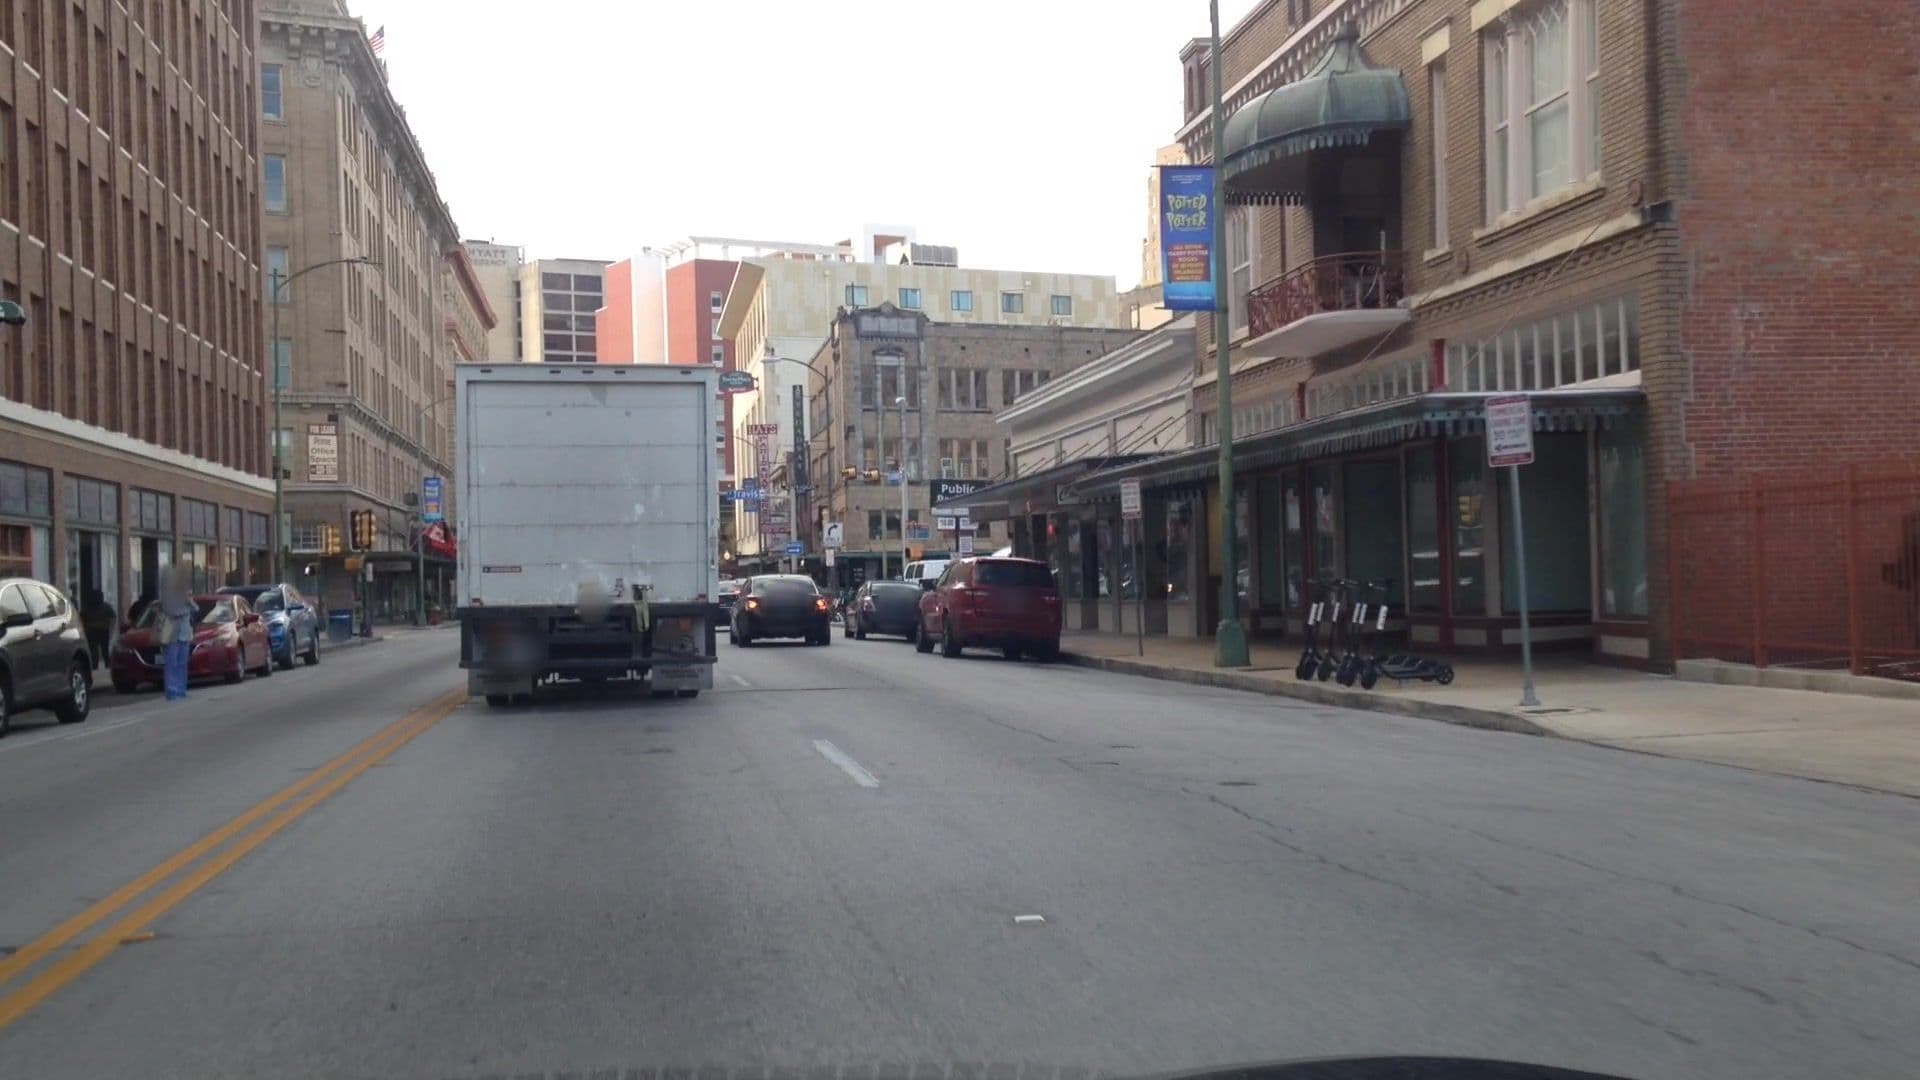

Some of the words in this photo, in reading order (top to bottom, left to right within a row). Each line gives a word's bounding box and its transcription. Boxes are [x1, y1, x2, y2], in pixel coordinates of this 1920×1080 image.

[1167, 194, 1208, 210] POTTED
[1166, 212, 1208, 230] POTTER
[467, 247, 506, 259] HYATT
[748, 425, 777, 435] HATS
[311, 447, 336, 455] Office
[311, 455, 337, 463] Space
[941, 484, 976, 494] Public
[732, 490, 758, 499] Travis
